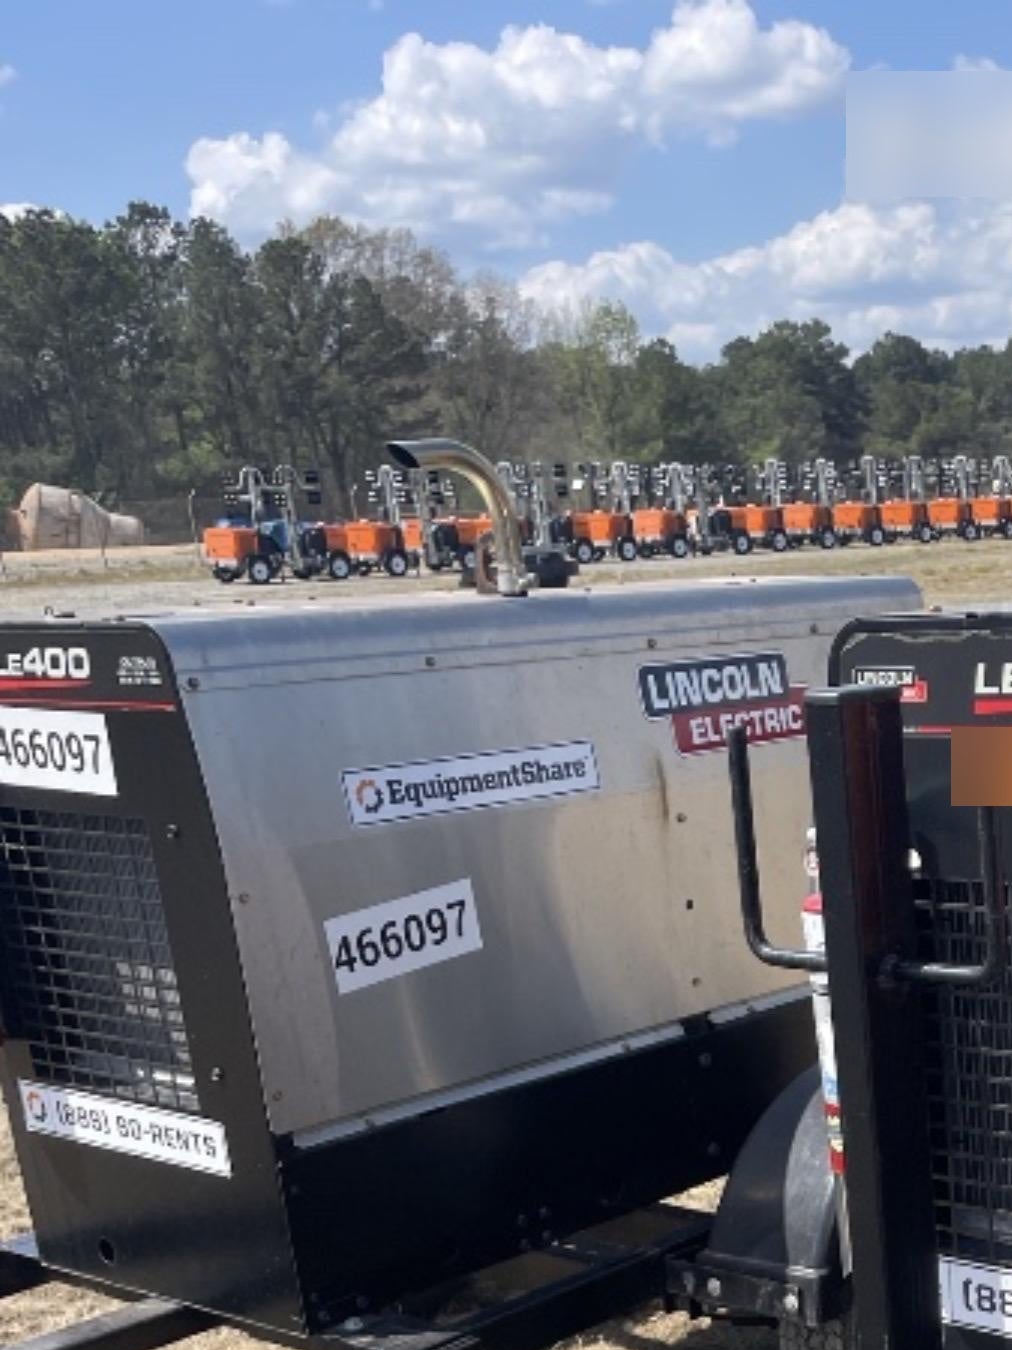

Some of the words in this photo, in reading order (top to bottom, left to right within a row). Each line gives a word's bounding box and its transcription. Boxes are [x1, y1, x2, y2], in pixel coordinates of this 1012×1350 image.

[647, 660, 784, 710] LINCOLN
[0, 725, 101, 775] 466097
[387, 758, 587, 807] EquipmentShare
[334, 900, 467, 975] 466097
